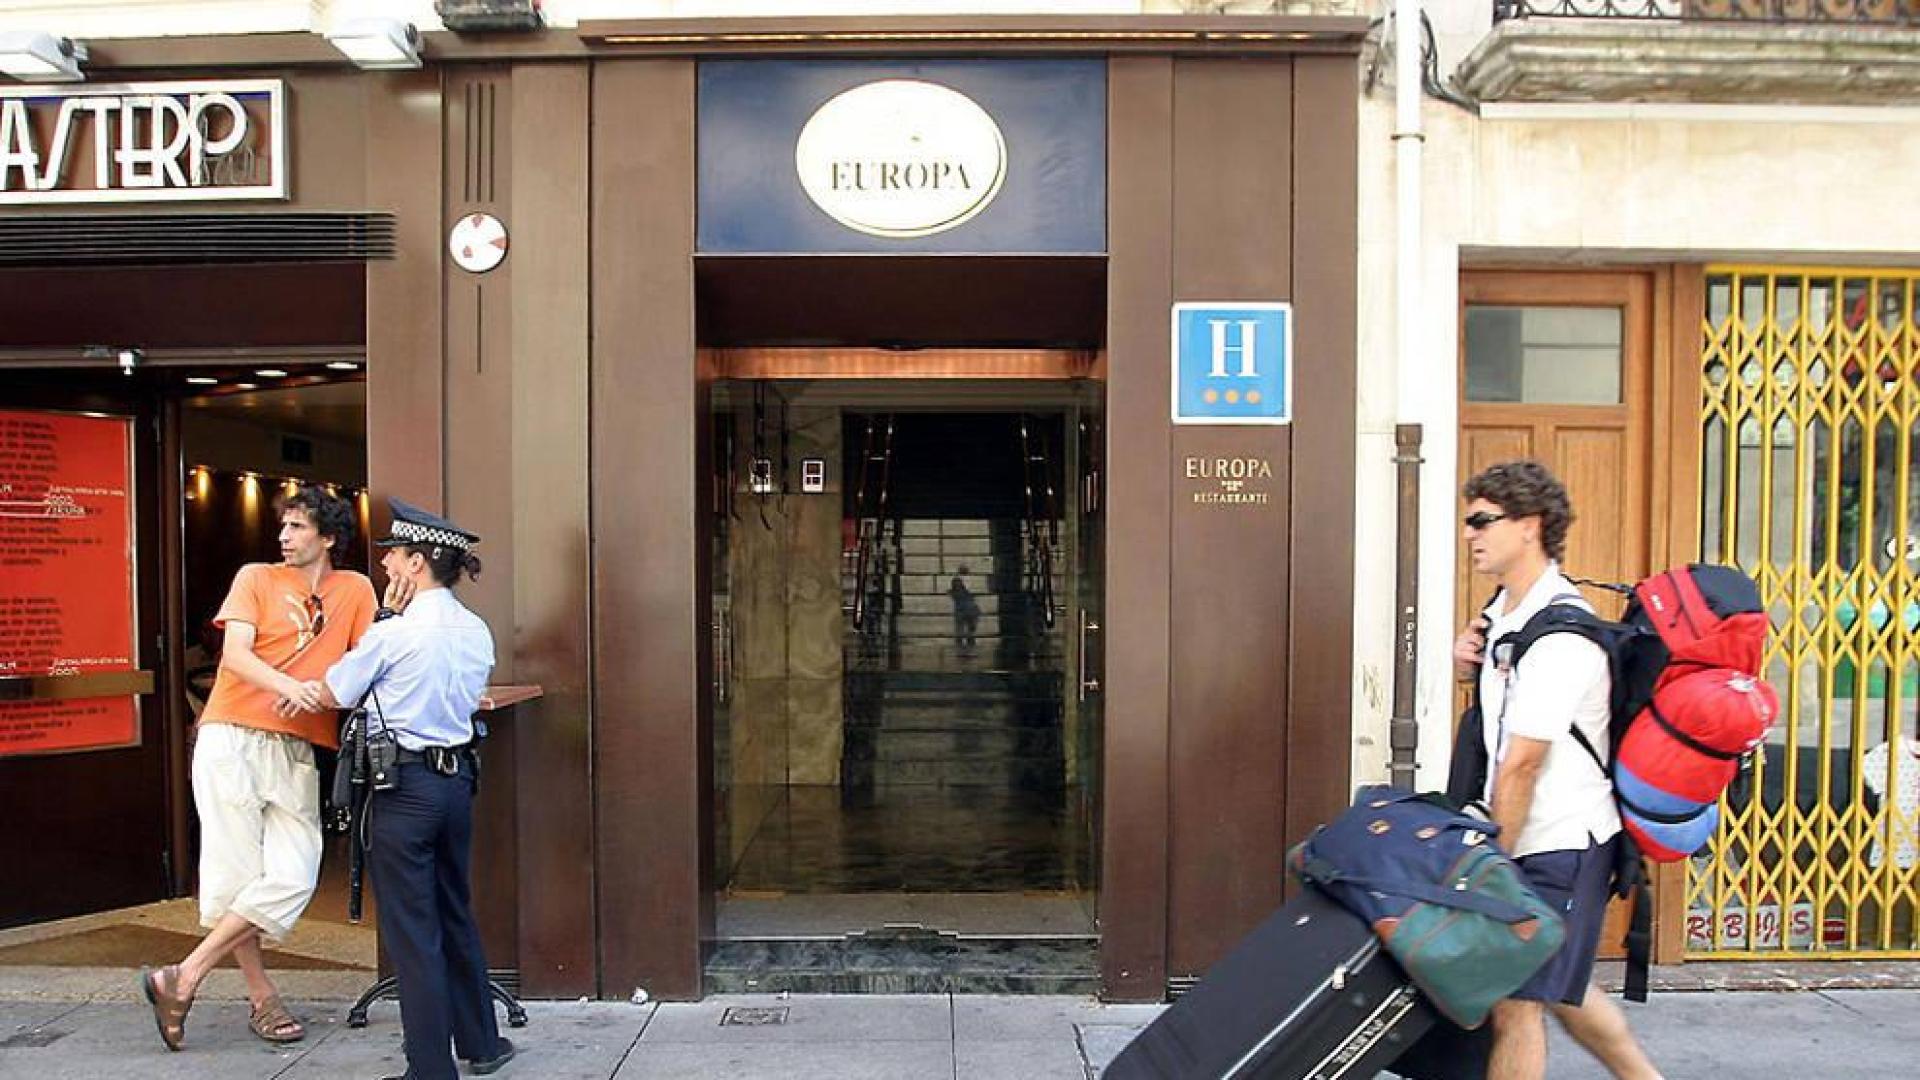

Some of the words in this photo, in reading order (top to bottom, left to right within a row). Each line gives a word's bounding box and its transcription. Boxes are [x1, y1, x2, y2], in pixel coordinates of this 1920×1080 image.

[832, 161, 970, 190] EUROPA
[1208, 319, 1261, 377] H
[1186, 458, 1273, 479] EUROPA
[1686, 910, 1811, 943] RBJS
